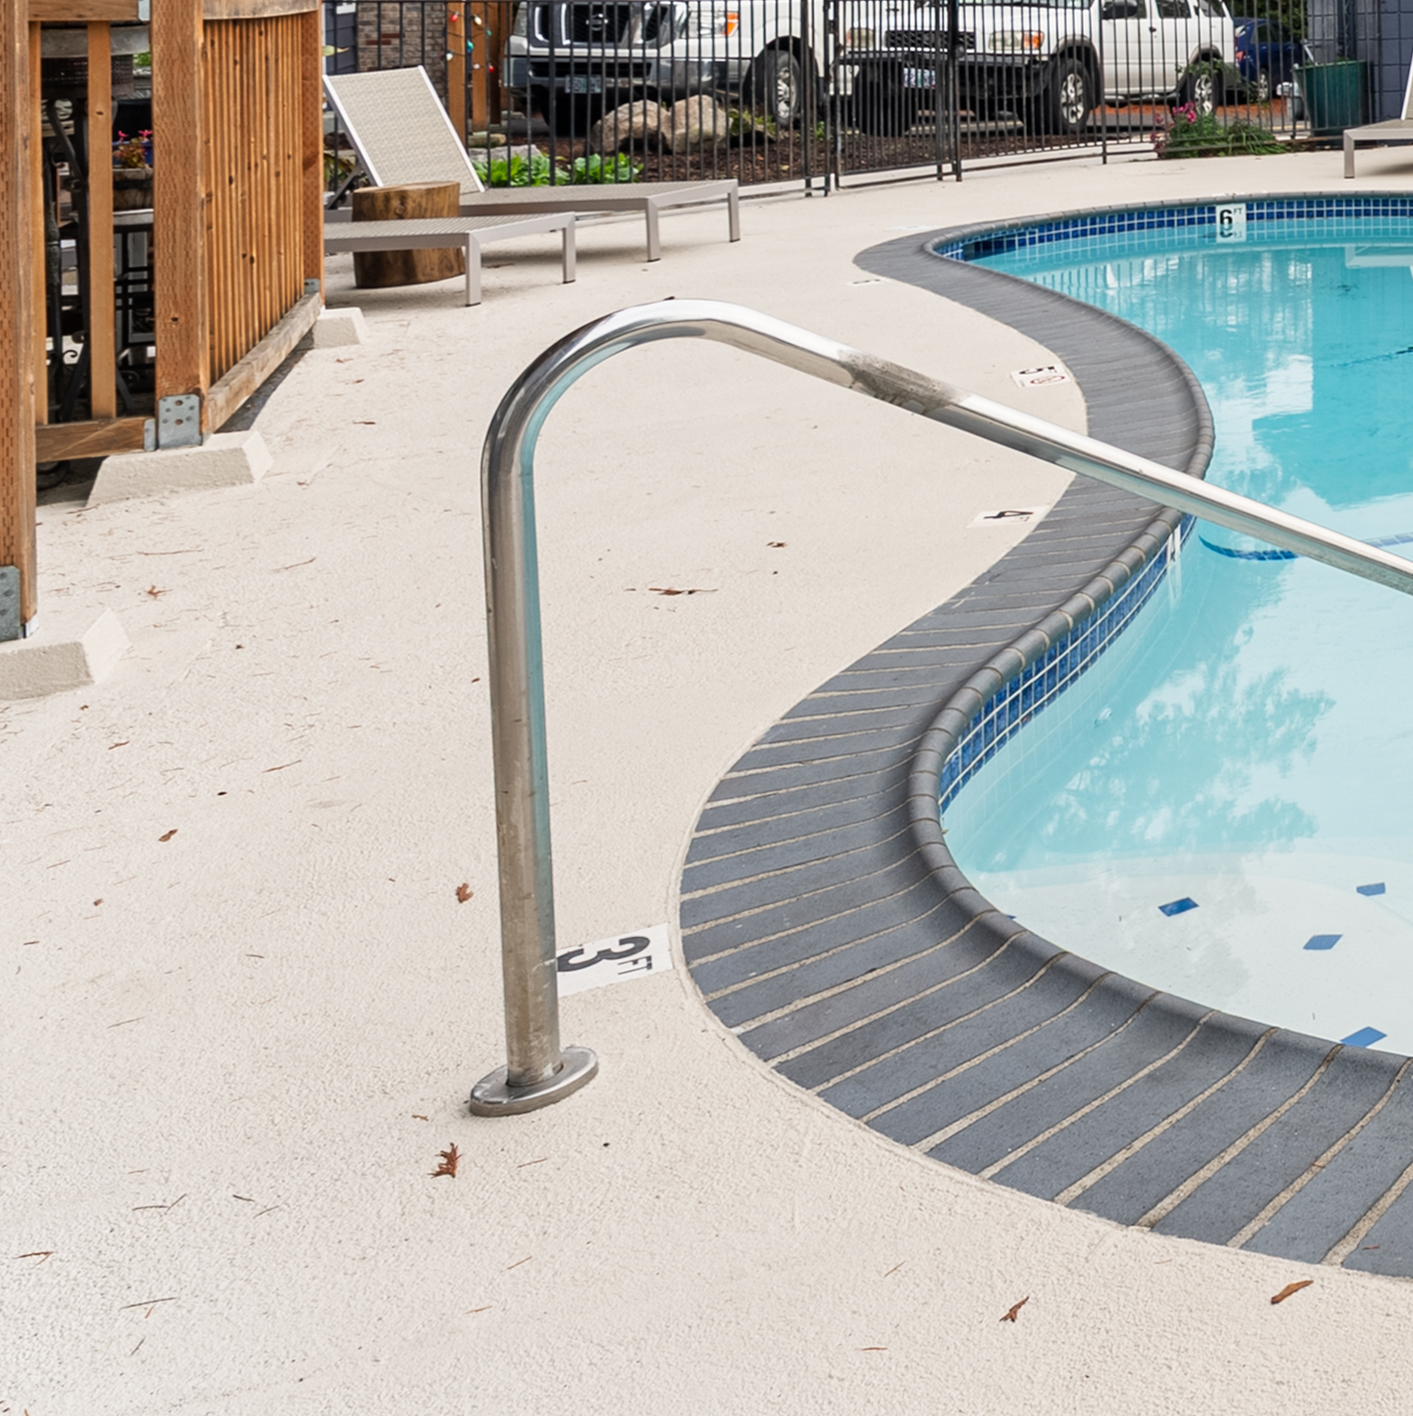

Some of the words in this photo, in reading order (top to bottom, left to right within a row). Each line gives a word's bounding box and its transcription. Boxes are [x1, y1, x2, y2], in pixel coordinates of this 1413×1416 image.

[1233, 207, 1243, 215] FT
[983, 510, 1034, 520] 4
[556, 936, 651, 973] 3
[617, 955, 653, 975] FT
